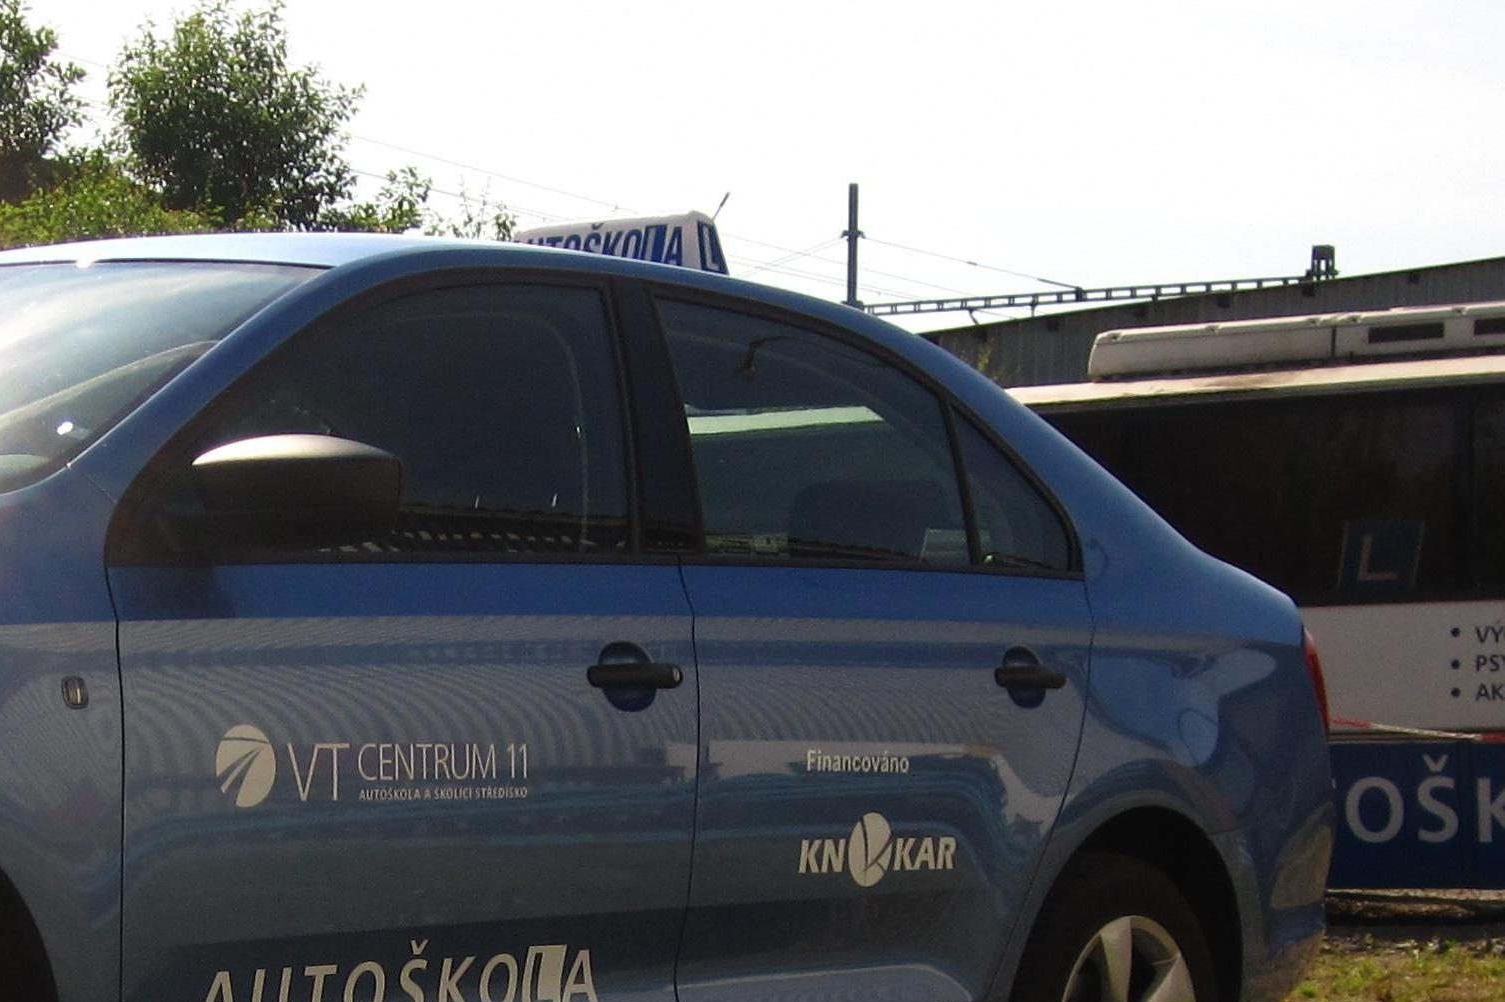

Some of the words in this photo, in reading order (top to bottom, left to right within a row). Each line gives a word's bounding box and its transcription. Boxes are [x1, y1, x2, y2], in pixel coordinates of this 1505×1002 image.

[1358, 535, 1398, 581] L
[288, 743, 350, 801] VT
[357, 743, 496, 781] CENTRUM
[507, 743, 528, 779] 11
[807, 750, 910, 773] Financováno
[358, 786, 421, 801] AUTOŠKOLA
[423, 788, 432, 800] A
